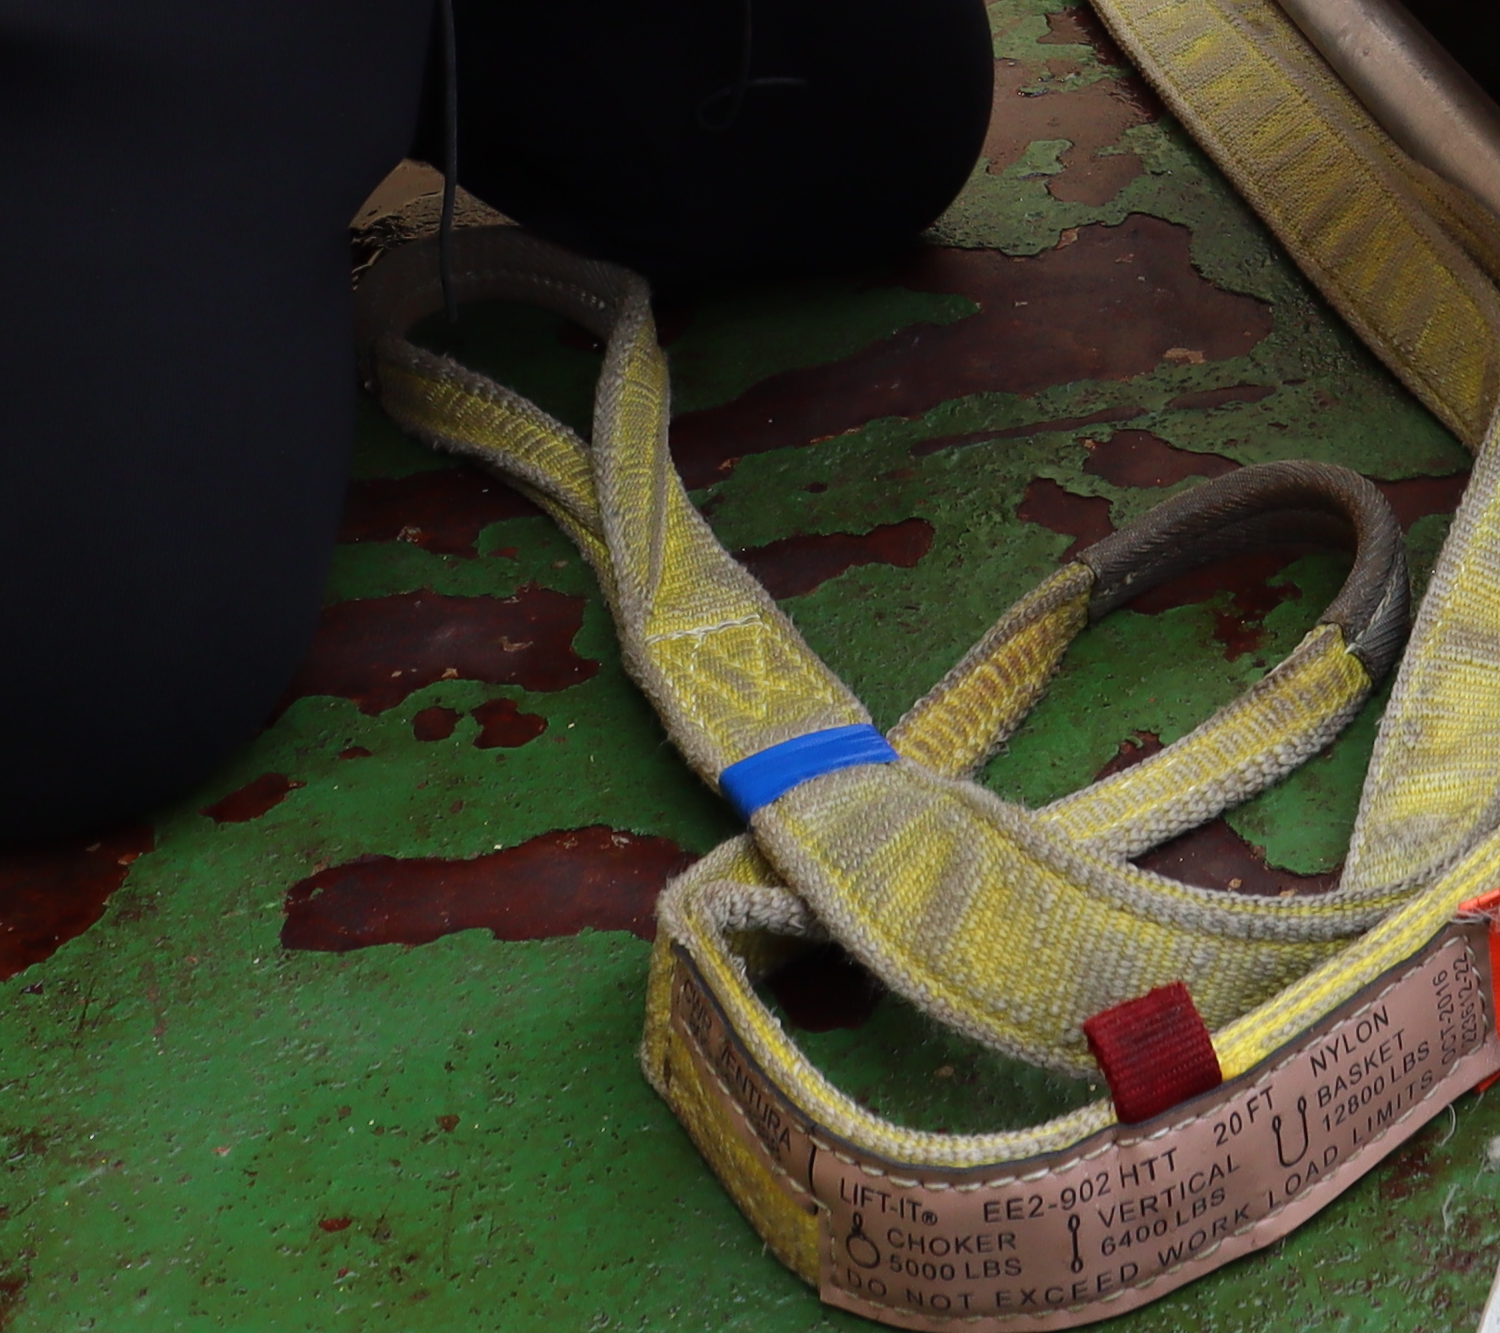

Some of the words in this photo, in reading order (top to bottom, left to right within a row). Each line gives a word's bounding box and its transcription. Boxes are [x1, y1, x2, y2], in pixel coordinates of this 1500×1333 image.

[1433, 970, 1456, 1066] OCT-2016
[1318, 1029, 1405, 1108] BASKET
[1322, 1076, 1384, 1132] 12800
[1392, 1041, 1430, 1083] LBS
[984, 1172, 1112, 1223] EE2-902
[1119, 1146, 1179, 1189] HTT
[1214, 1112, 1242, 1146] 20
[1247, 1086, 1274, 1123] FT
[1309, 1005, 1389, 1077] NYLON
[846, 1267, 887, 1298] DO
[907, 1288, 973, 1311] NOT
[996, 1262, 1139, 1307] EXCEED
[1156, 1203, 1250, 1269] WORK
[1268, 1145, 1338, 1209] LOAD
[1352, 1069, 1433, 1146] LIMITS
[1098, 1155, 1240, 1229] VERTICAL
[1101, 1219, 1168, 1257] 6400
[1175, 1188, 1226, 1228] LBS
[887, 1227, 1016, 1257] CHOKER
[890, 1255, 955, 1281] 5000
[966, 1258, 1022, 1280] LBS
